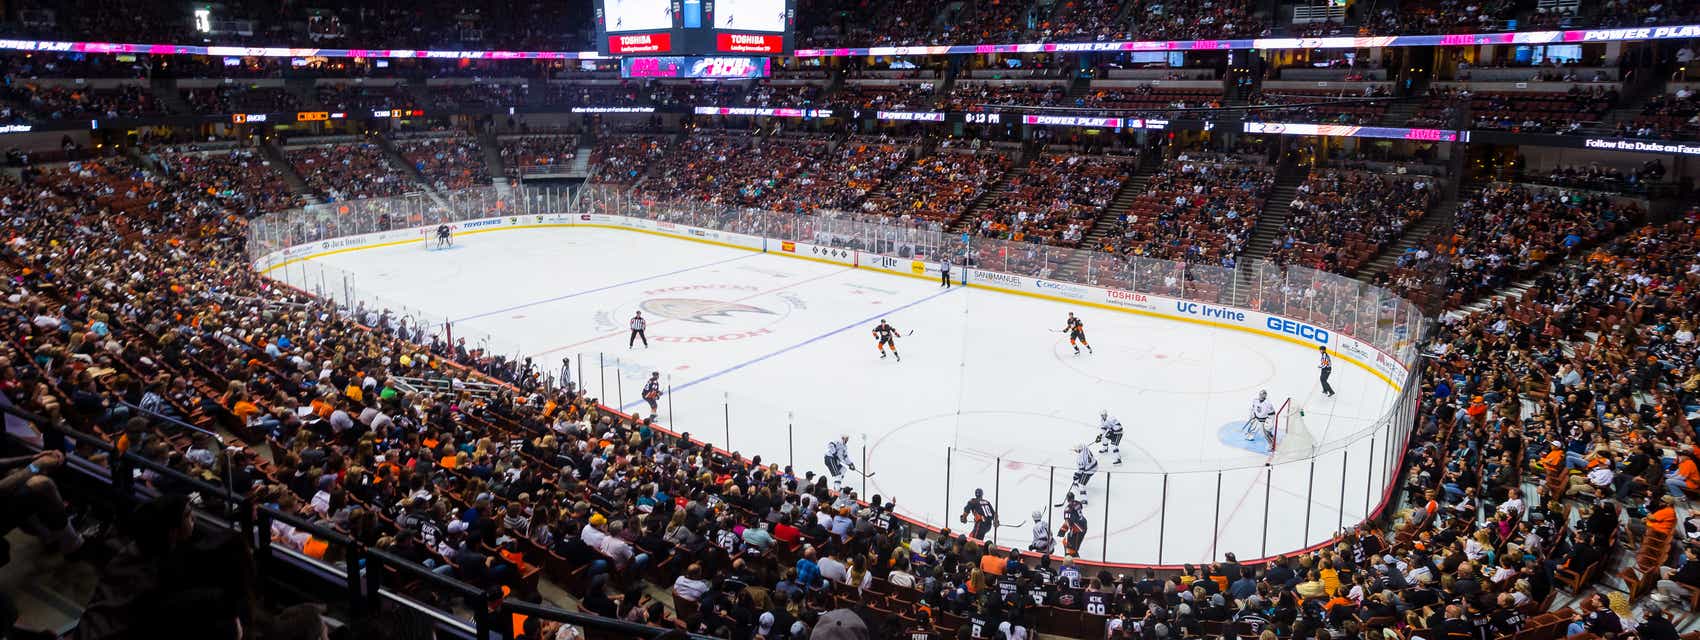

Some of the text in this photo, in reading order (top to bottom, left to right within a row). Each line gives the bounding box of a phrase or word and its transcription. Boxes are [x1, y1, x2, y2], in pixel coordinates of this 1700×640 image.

[621, 35, 652, 45] TOSHIBA
[731, 35, 765, 45] TOSHIBA
[1583, 29, 1650, 41] POWER
[38, 41, 73, 51] PLAY
[461, 51, 484, 59] PLAY
[703, 57, 751, 68] POWER
[882, 111, 937, 120] POWER PLAY
[988, 114, 1000, 123] PM
[1037, 115, 1106, 126] POWER PLAY
[1585, 139, 1617, 149] Follow
[1617, 141, 1634, 150] the
[1635, 142, 1663, 152] Ducks
[1664, 145, 1678, 153] on
[881, 256, 898, 268] Lite
[974, 270, 1021, 286] SAN MANUEL
[1106, 290, 1148, 303] TOSHIBA
[1176, 301, 1245, 322] UC Irvine
[1266, 316, 1329, 344] GEICO
